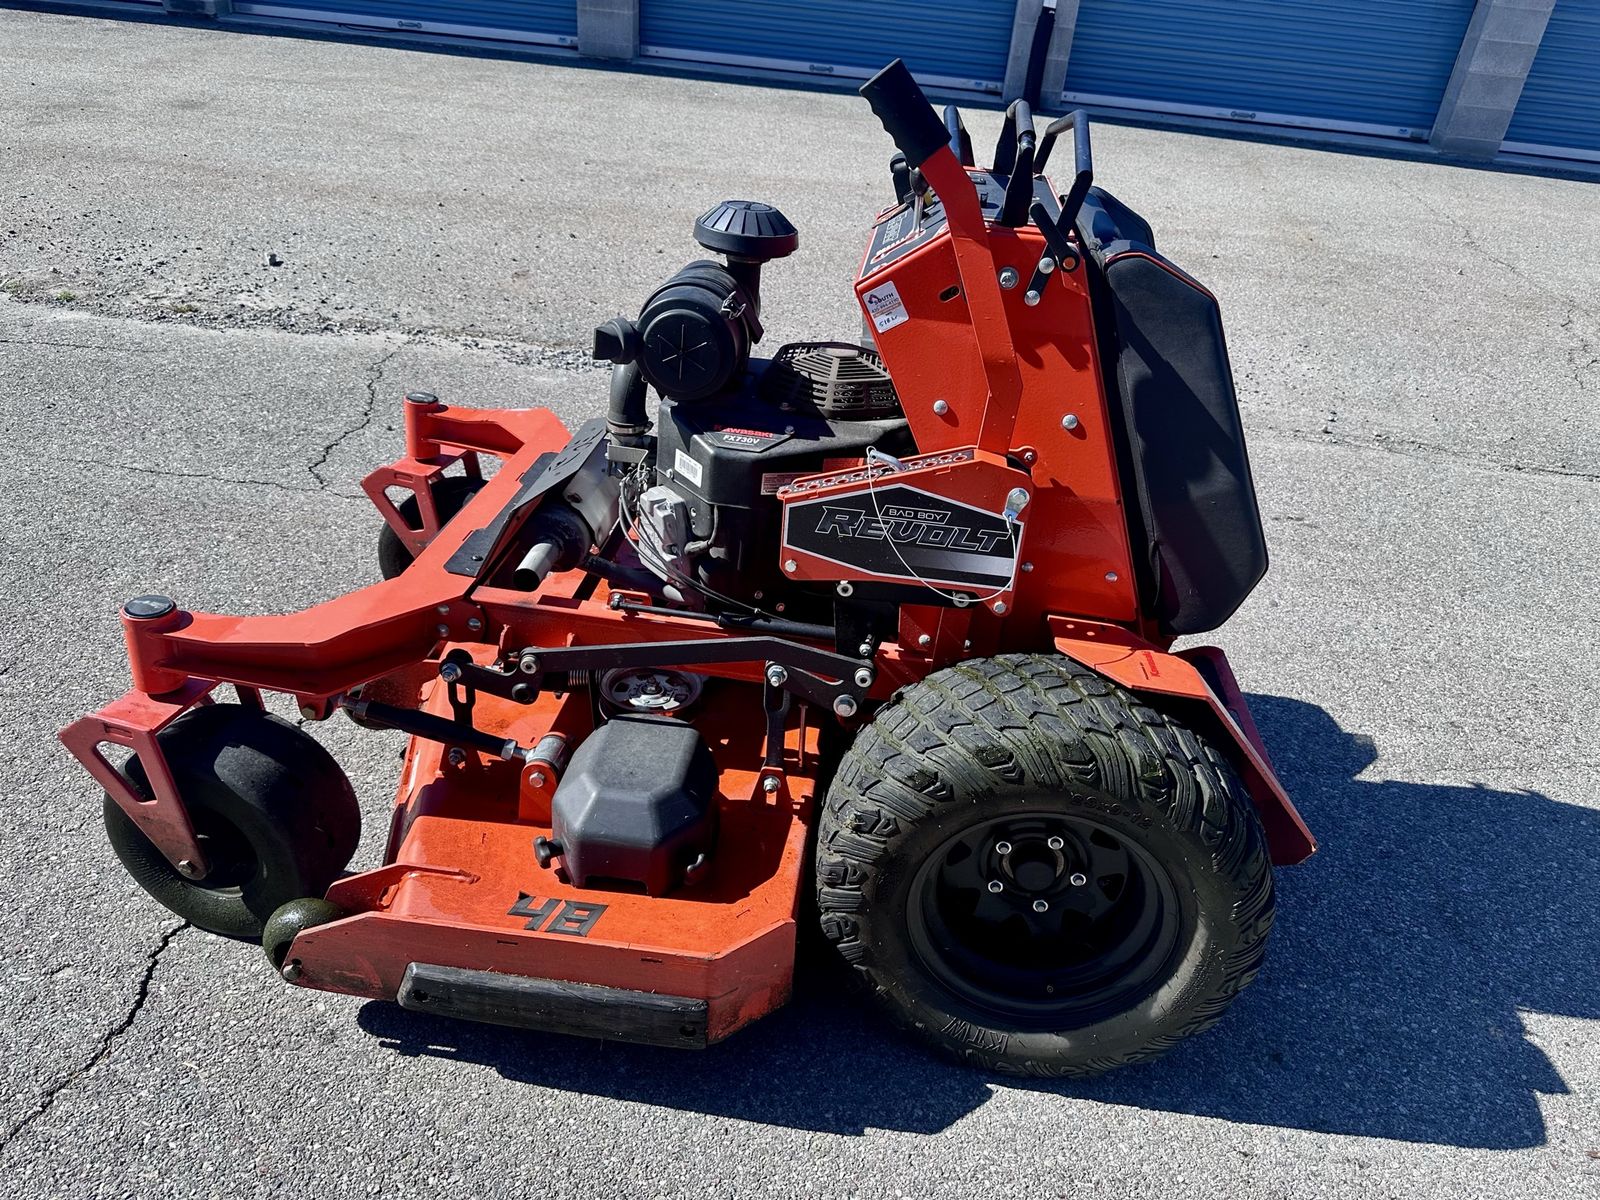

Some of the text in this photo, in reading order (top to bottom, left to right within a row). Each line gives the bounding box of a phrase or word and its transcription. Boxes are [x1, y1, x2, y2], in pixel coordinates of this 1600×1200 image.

[722, 434, 760, 444] FX730V
[815, 505, 1011, 552] REVOLT
[888, 508, 943, 521] BAD BOY
[507, 890, 609, 937] 48
